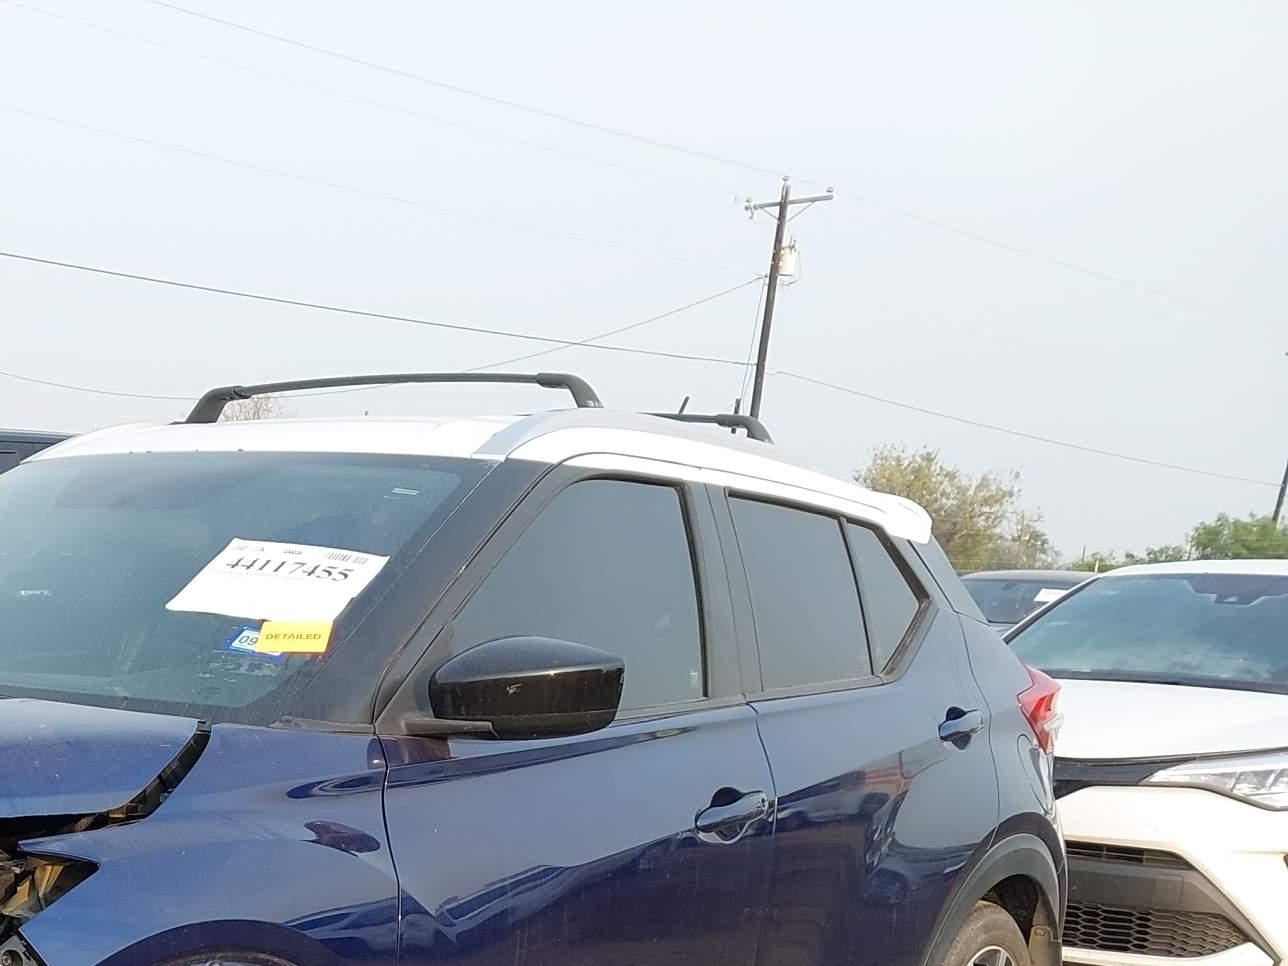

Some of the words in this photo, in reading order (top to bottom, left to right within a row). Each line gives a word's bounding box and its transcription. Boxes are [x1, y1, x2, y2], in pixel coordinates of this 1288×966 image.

[225, 557, 355, 582] 44117455
[237, 634, 259, 646] 09
[264, 632, 323, 641] DETAILED
